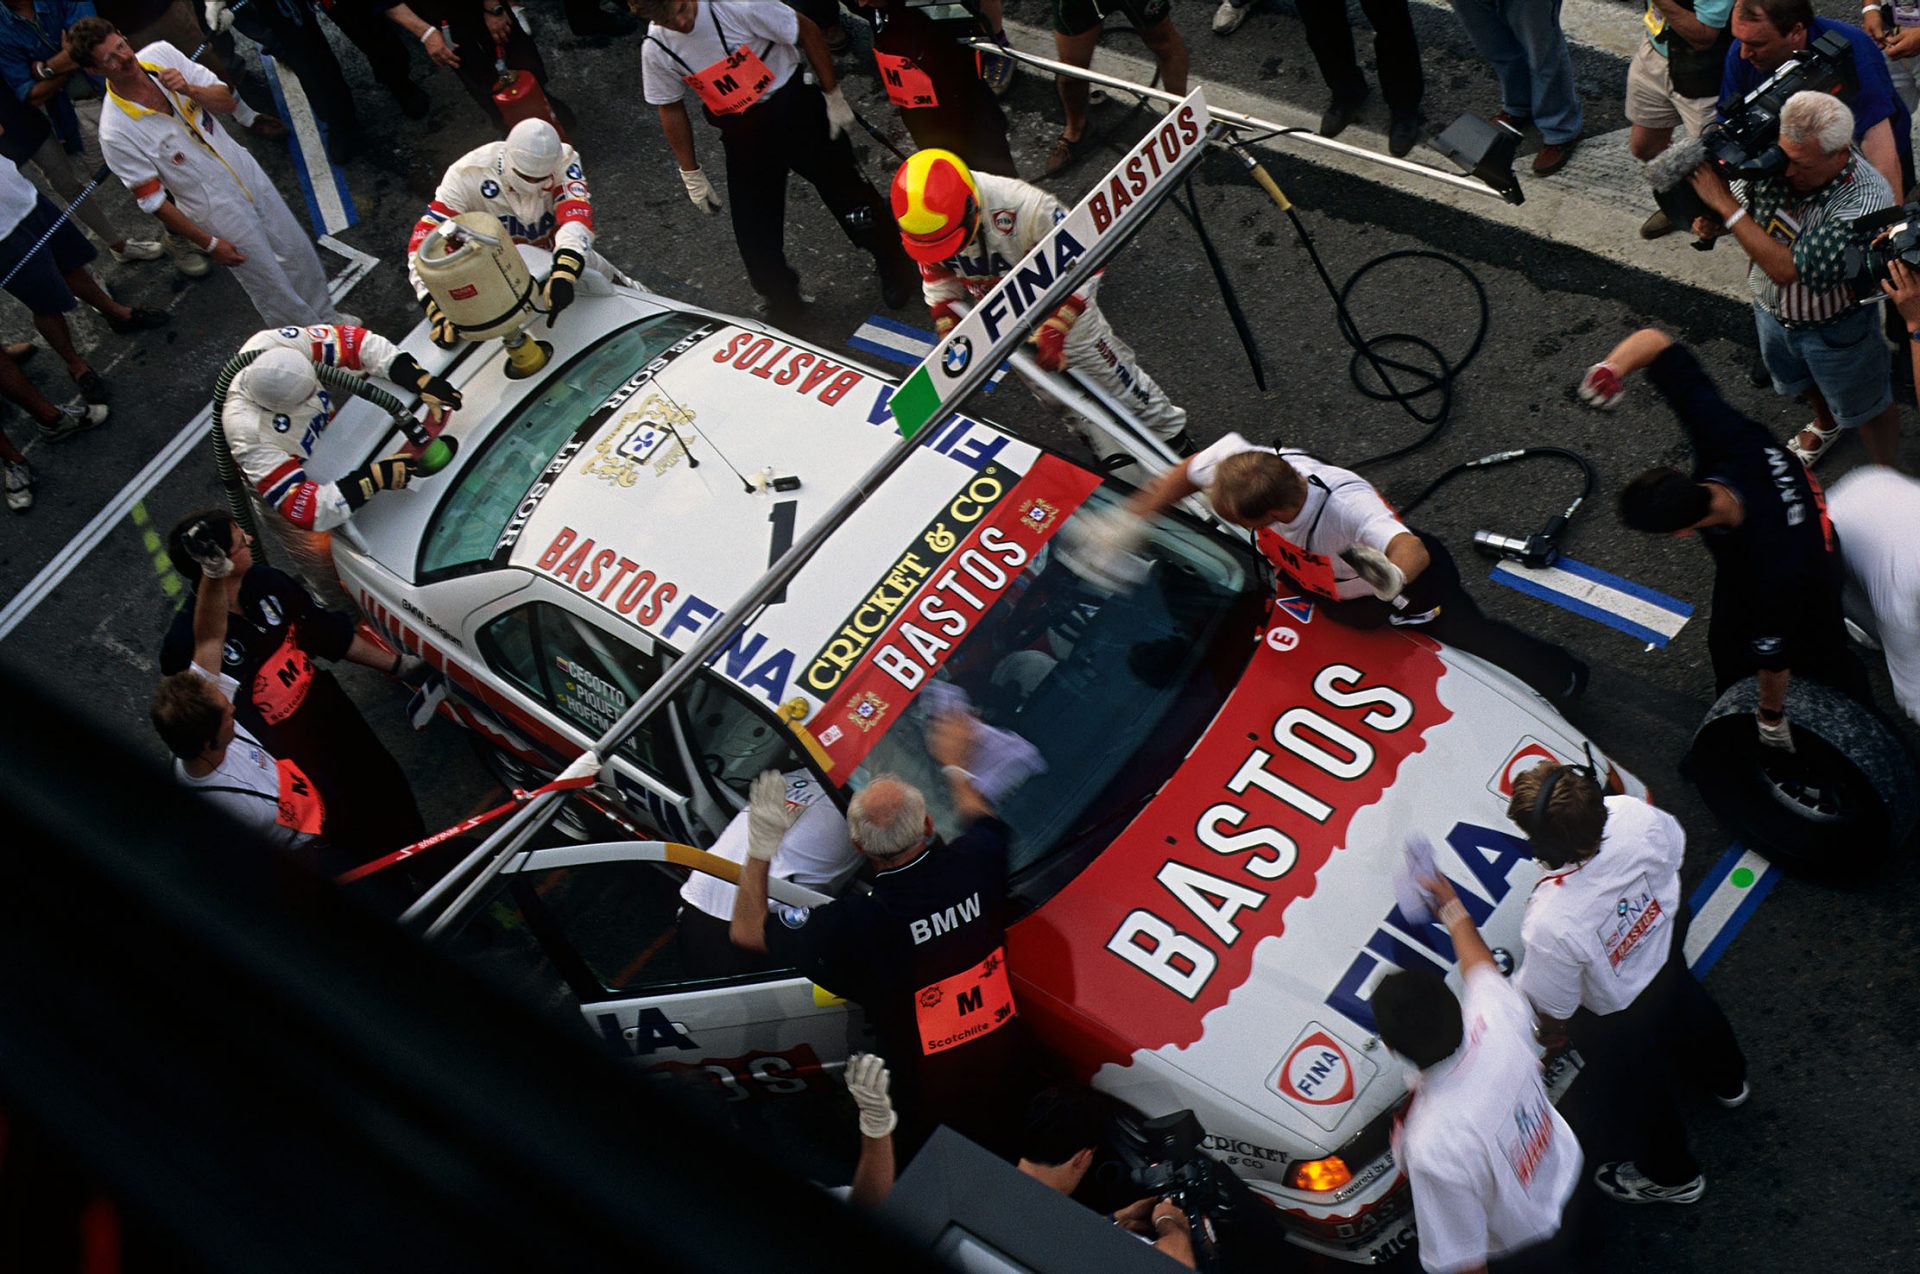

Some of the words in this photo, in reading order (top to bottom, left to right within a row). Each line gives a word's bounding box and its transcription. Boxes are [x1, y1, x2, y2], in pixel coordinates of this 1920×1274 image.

[713, 74, 740, 96] M
[753, 74, 770, 94] 3M
[883, 66, 904, 88] M
[913, 95, 933, 105] 3M
[1088, 105, 1198, 235] BASTOS
[979, 229, 1087, 345] FINA
[670, 323, 715, 354] LE
[600, 357, 669, 412] SOIR
[714, 333, 864, 407] BASTOS
[546, 438, 586, 474] LE
[291, 482, 315, 520] BASTOS
[1763, 447, 1807, 527] BMW
[498, 482, 550, 549] SOIR
[767, 500, 797, 605] 1
[1278, 544, 1300, 570] M
[536, 526, 677, 627] BASTOS
[402, 598, 424, 622] BMW
[808, 552, 931, 692] CRICKET
[924, 522, 957, 555] &
[872, 525, 1027, 691] BASTOS
[660, 594, 796, 706] FNA
[1271, 632, 1295, 647] E
[276, 658, 300, 688] M
[568, 661, 626, 707] CECOTTO
[576, 684, 621, 722] PIQUET
[1105, 662, 1415, 1003] BASTOS
[909, 891, 982, 945] BMW
[1617, 892, 1650, 937] FINA
[1617, 903, 1658, 957] BASTOS
[956, 985, 984, 1017] M
[994, 1002, 1011, 1024] 3M
[928, 1022, 989, 1050] Scotchlite
[1297, 1050, 1340, 1097] FINA
[1200, 1133, 1289, 1164] CRICKET
[1227, 1155, 1240, 1166] &
[1241, 1157, 1264, 1170] CO
[1334, 1172, 1373, 1202] Powered
[1373, 1162, 1386, 1176] by
